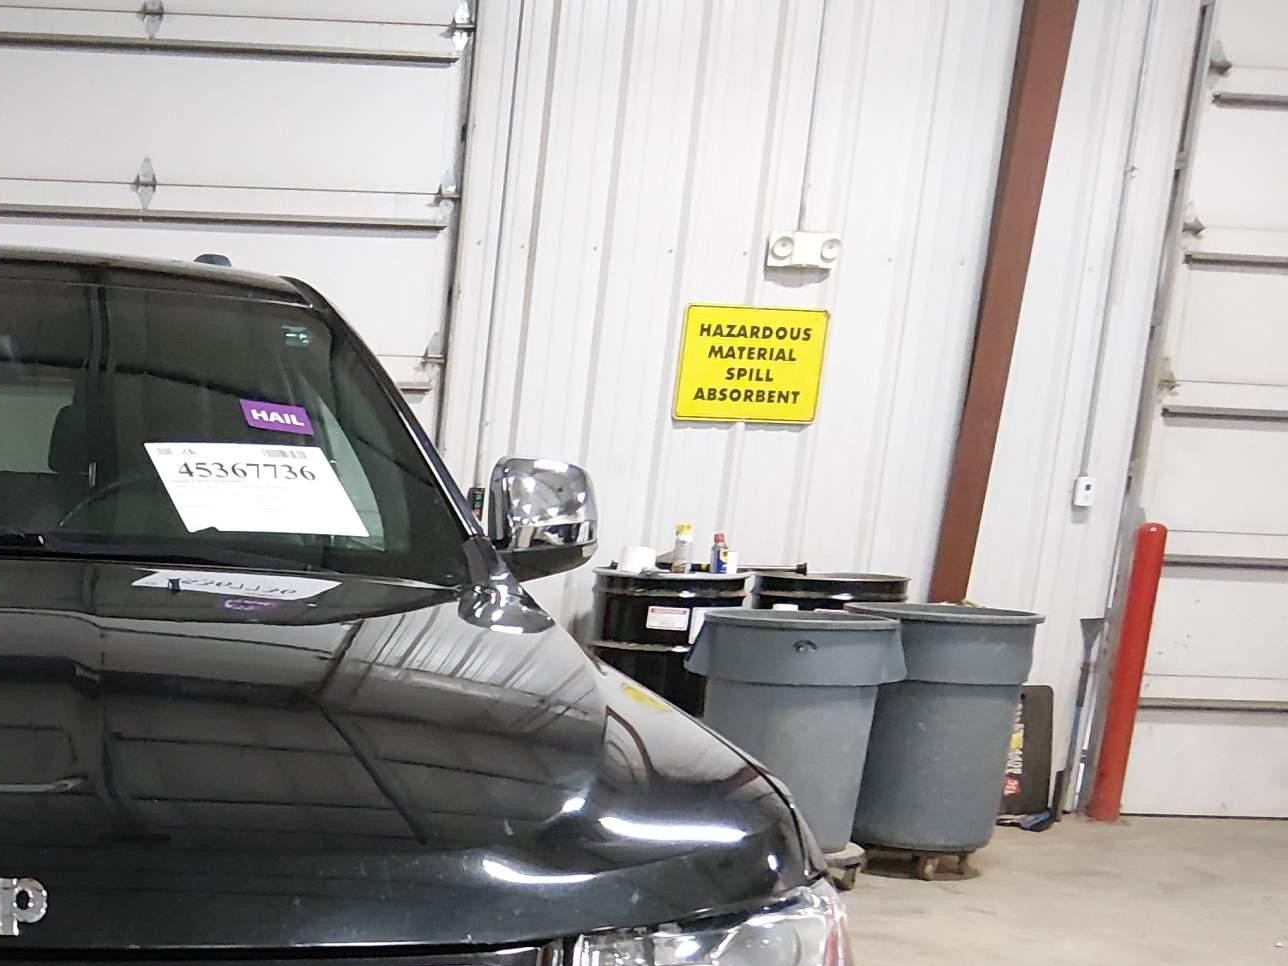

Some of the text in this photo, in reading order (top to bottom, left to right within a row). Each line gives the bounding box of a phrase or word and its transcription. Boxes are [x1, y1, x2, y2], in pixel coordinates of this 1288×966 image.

[699, 324, 812, 341] HAZARDOUS
[708, 345, 797, 362] MATERIAL
[725, 367, 774, 382] SPILL
[693, 387, 800, 404] ABSORBENT
[250, 408, 305, 427] HAIL
[179, 462, 316, 481] 45367736
